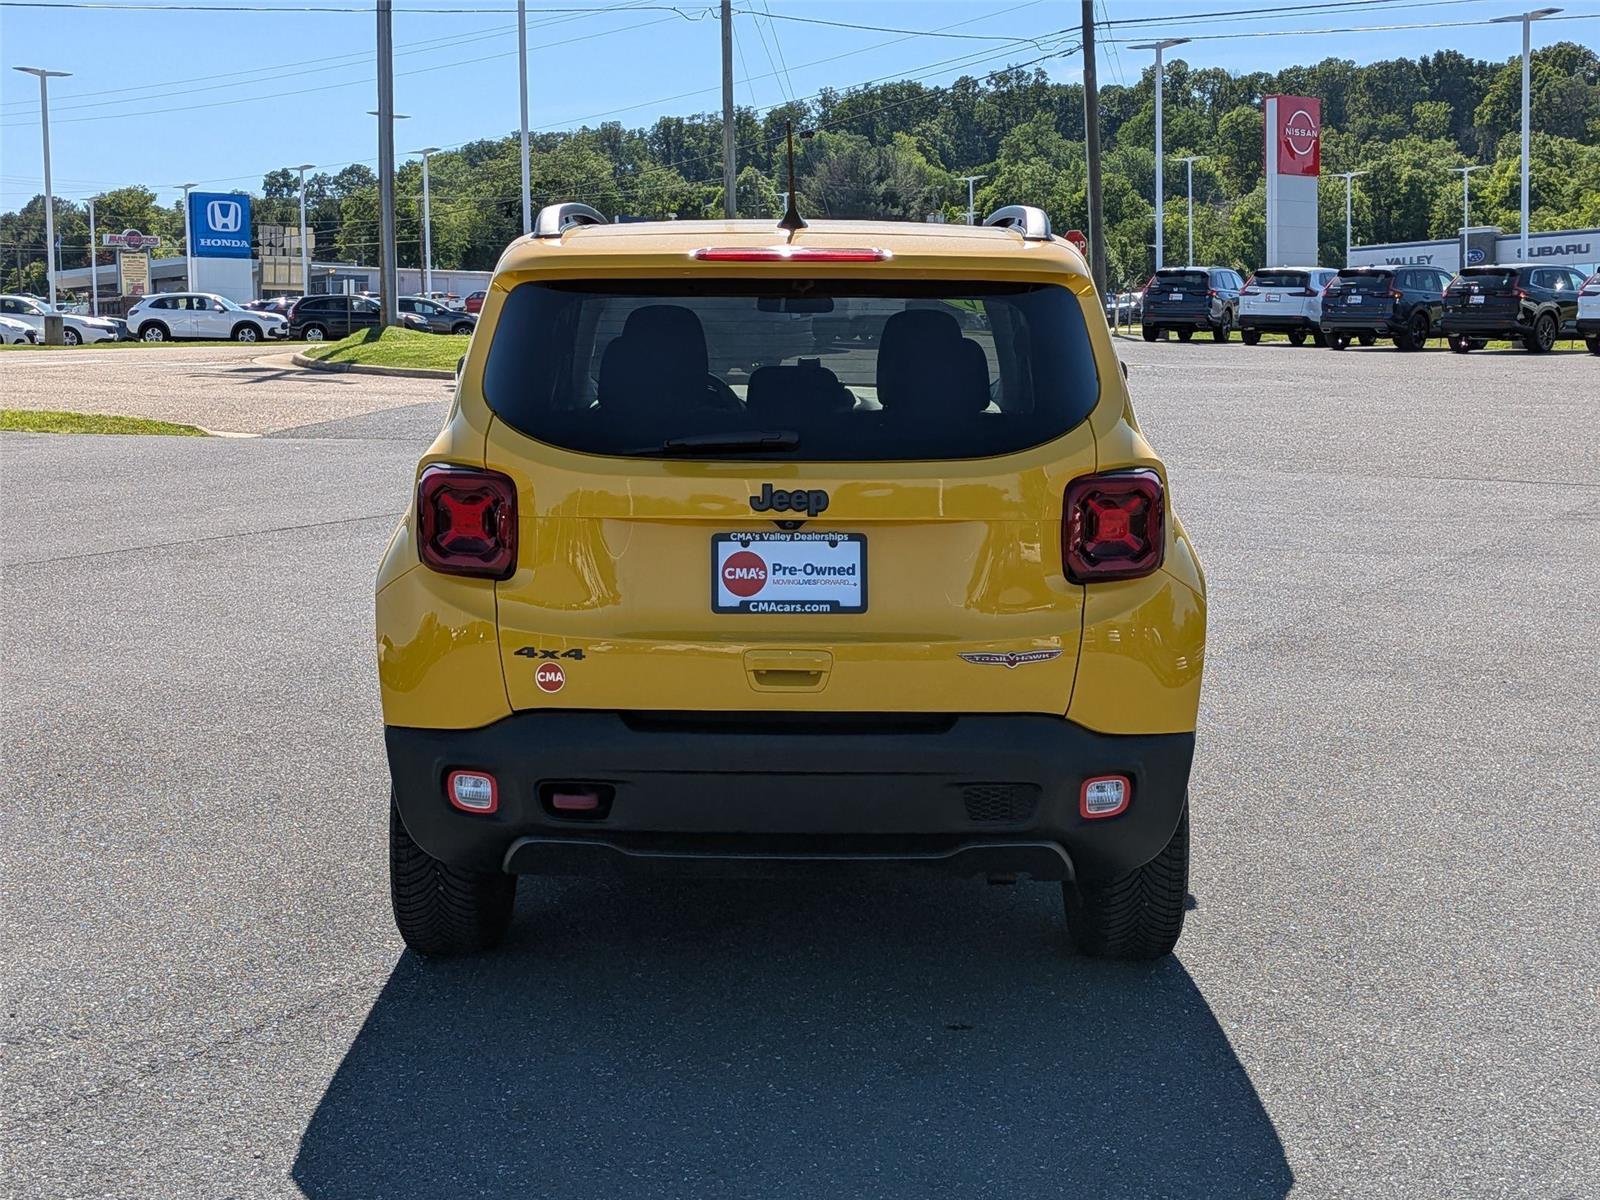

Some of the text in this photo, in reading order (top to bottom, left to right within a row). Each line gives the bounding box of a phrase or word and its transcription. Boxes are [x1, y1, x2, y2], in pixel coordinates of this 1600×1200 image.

[1285, 128, 1317, 137] NISSAN
[199, 238, 249, 248] HONDA
[1385, 254, 1434, 266] VALLEY
[750, 483, 829, 517] Jeep
[730, 532, 849, 542] CMA's Valley Dealerships
[724, 567, 766, 580] CMA's
[772, 563, 856, 576] Pre-Owned
[749, 602, 830, 612] CMAcars.com
[514, 646, 586, 660] 4x4
[537, 671, 564, 682] CMA
